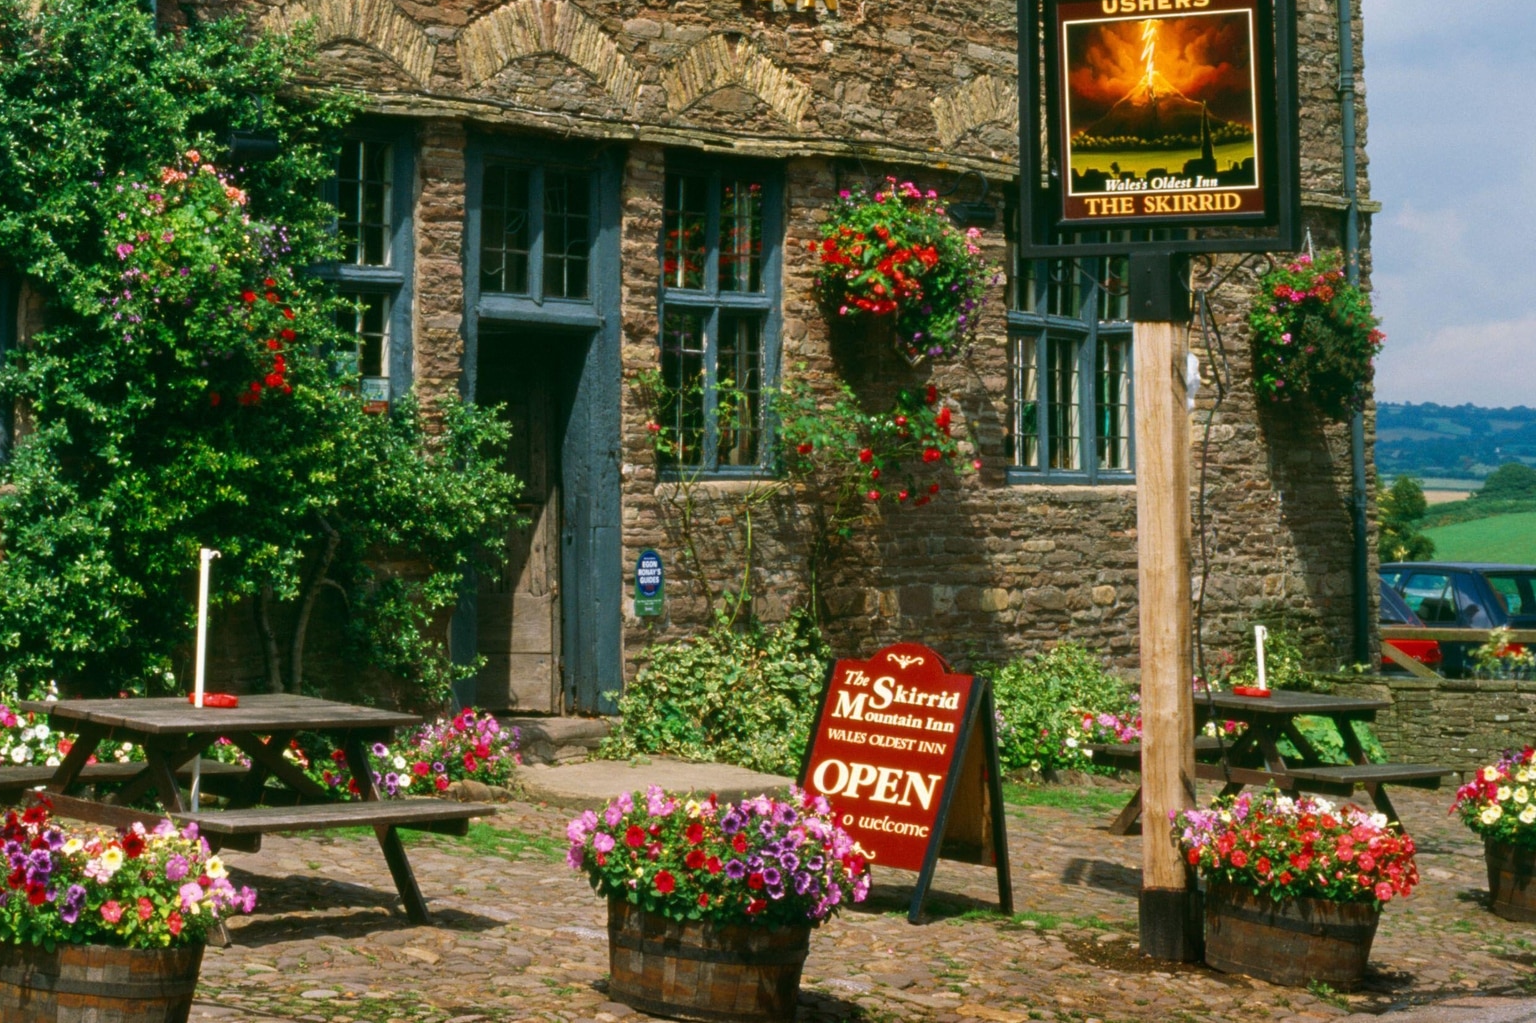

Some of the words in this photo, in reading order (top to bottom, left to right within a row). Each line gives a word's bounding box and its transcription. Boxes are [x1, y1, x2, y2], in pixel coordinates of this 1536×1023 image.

[1105, 177, 1148, 192] Wales's
[1150, 175, 1192, 190] Oldest
[1195, 175, 1219, 188] Inn
[1084, 196, 1135, 216] THE
[1143, 192, 1242, 214] SKIRRID
[642, 560, 658, 568] EGON
[639, 576, 660, 584] GUIDES
[844, 669, 870, 687] The
[868, 676, 961, 710] Skirrid
[831, 689, 922, 728] Mountain
[925, 717, 955, 733] Inn
[827, 727, 867, 744] WALES
[869, 734, 917, 751] OLDEST
[917, 740, 947, 755] INN
[813, 758, 942, 811] OPEN
[858, 815, 929, 838] welcome
